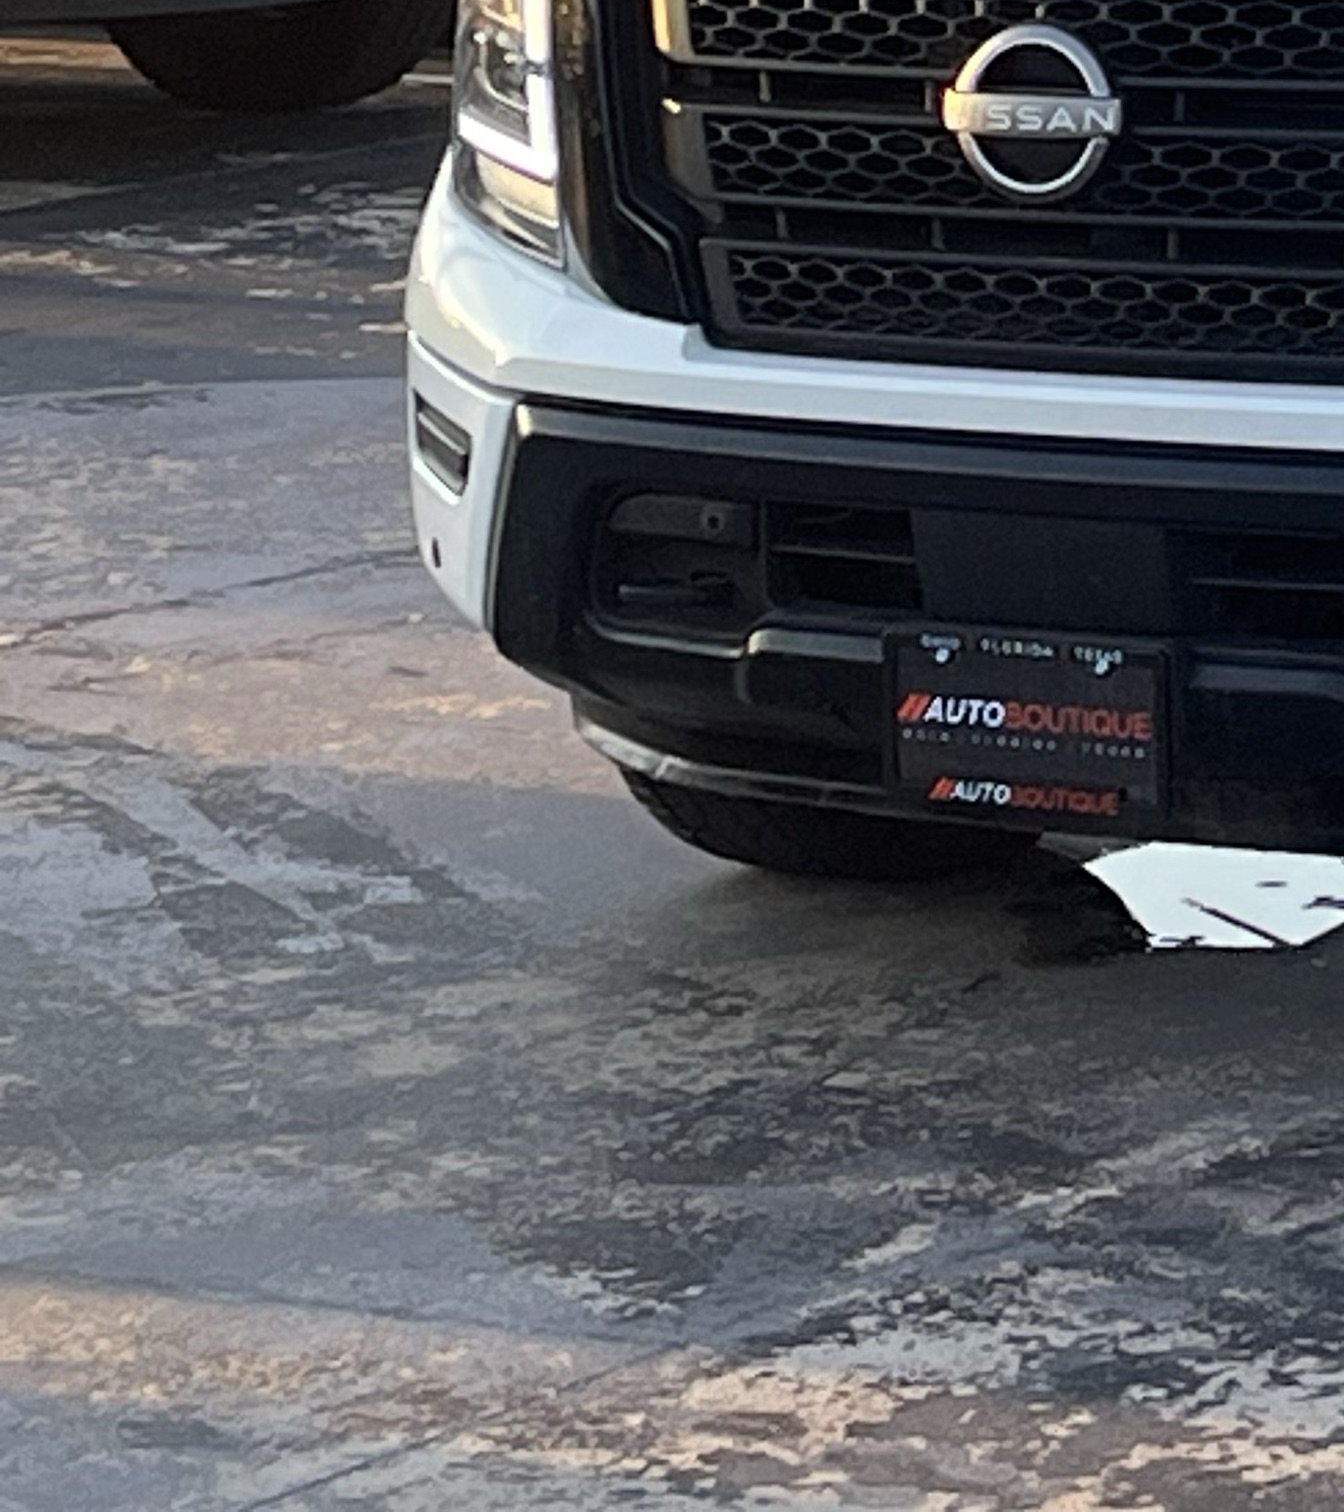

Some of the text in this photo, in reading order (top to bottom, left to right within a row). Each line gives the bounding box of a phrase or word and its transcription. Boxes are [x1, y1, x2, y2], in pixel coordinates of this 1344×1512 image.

[955, 102, 1116, 134] ISSAN
[924, 695, 1153, 739] AUTOBOUTIQUE
[950, 780, 1119, 815] AUTOBOUTIQUE
